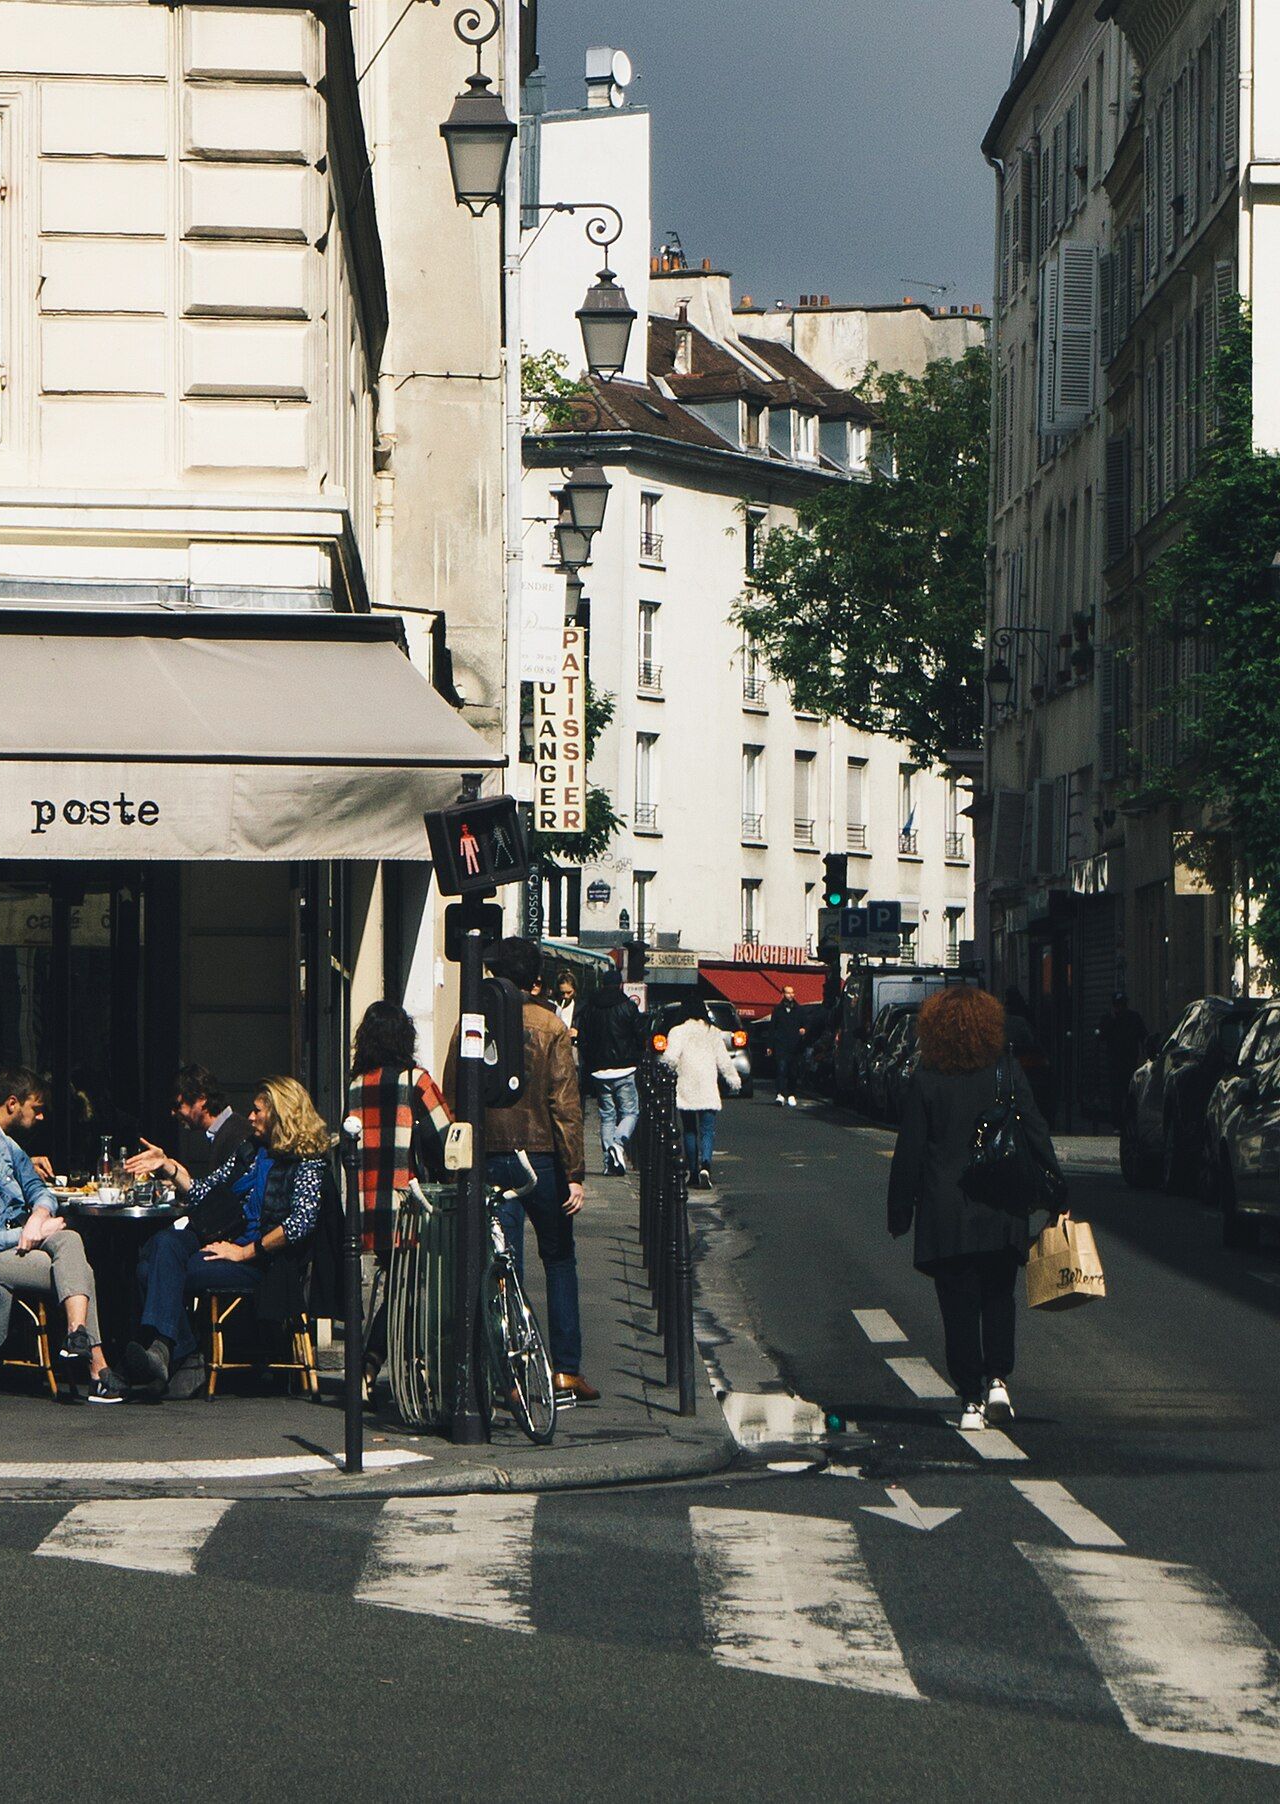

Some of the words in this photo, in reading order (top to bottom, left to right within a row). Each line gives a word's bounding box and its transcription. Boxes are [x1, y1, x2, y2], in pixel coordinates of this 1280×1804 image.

[521, 582, 555, 593] ENDRE
[562, 631, 580, 829] PATISSIER
[539, 683, 557, 829] ULANGER
[31, 792, 160, 833] poste
[528, 874, 539, 933] CUISSONS
[877, 907, 891, 928] P
[848, 914, 861, 934] P
[734, 943, 808, 965] BOUCHERIE
